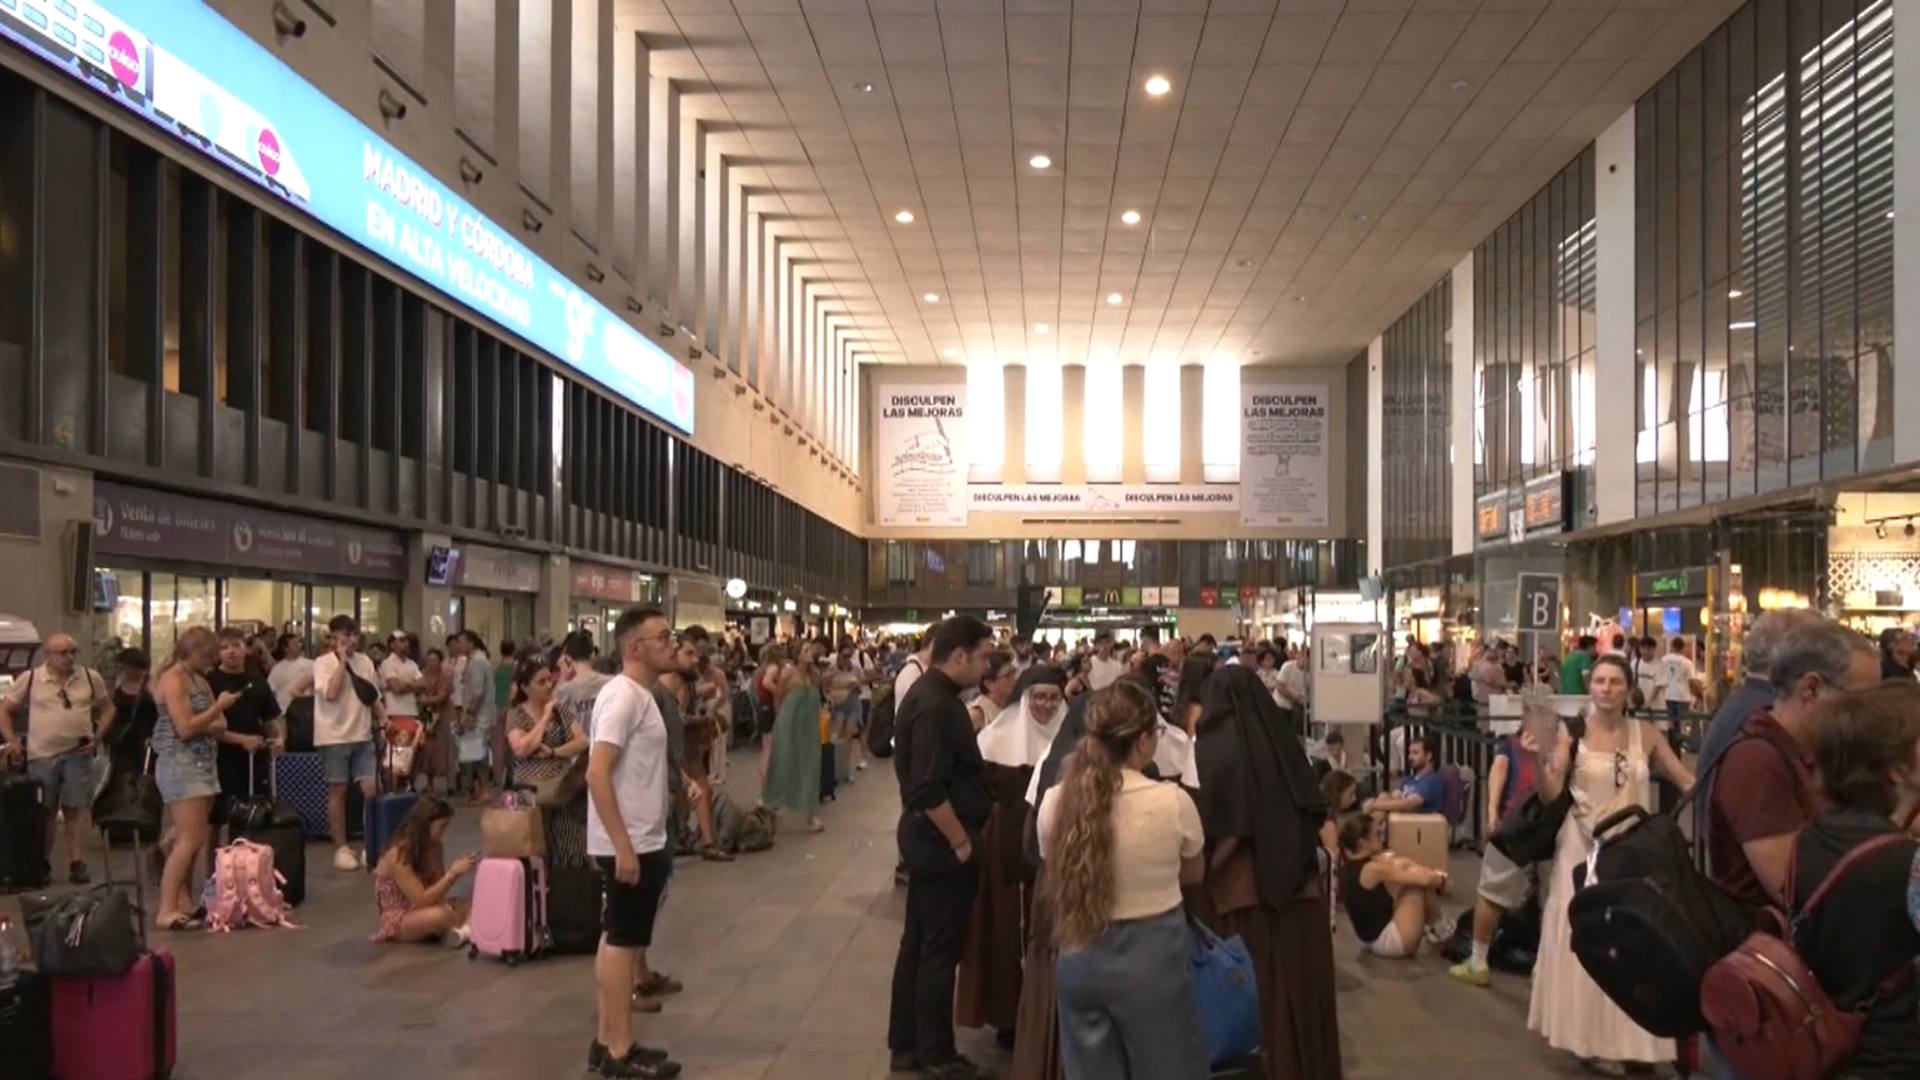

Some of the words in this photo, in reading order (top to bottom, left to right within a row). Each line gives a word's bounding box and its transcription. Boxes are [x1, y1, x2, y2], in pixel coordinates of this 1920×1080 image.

[364, 141, 442, 227] MADRID
[446, 201, 459, 238] Y
[461, 215, 534, 291] CÓRDOBA
[367, 200, 396, 247] EN
[400, 223, 445, 279] ALTA
[447, 252, 531, 328] VELOCIDAD
[891, 395, 955, 406] DISCULPEN
[1252, 395, 1317, 406] DISCULPEN
[883, 407, 905, 418] LAS
[907, 407, 963, 418] MEJORAS
[1244, 407, 1266, 418] LAS
[1268, 407, 1325, 418] MEJORAS
[974, 493, 1020, 502] DISCULPEN
[1021, 493, 1038, 502] LAS
[1039, 493, 1081, 502] MEJORAS
[1125, 493, 1173, 502] DISCULPEN
[1174, 493, 1190, 502] LAS
[1192, 493, 1234, 502] MEJORAS
[120, 500, 155, 523] Venta
[157, 507, 172, 526] de
[1532, 592, 1549, 626] B
